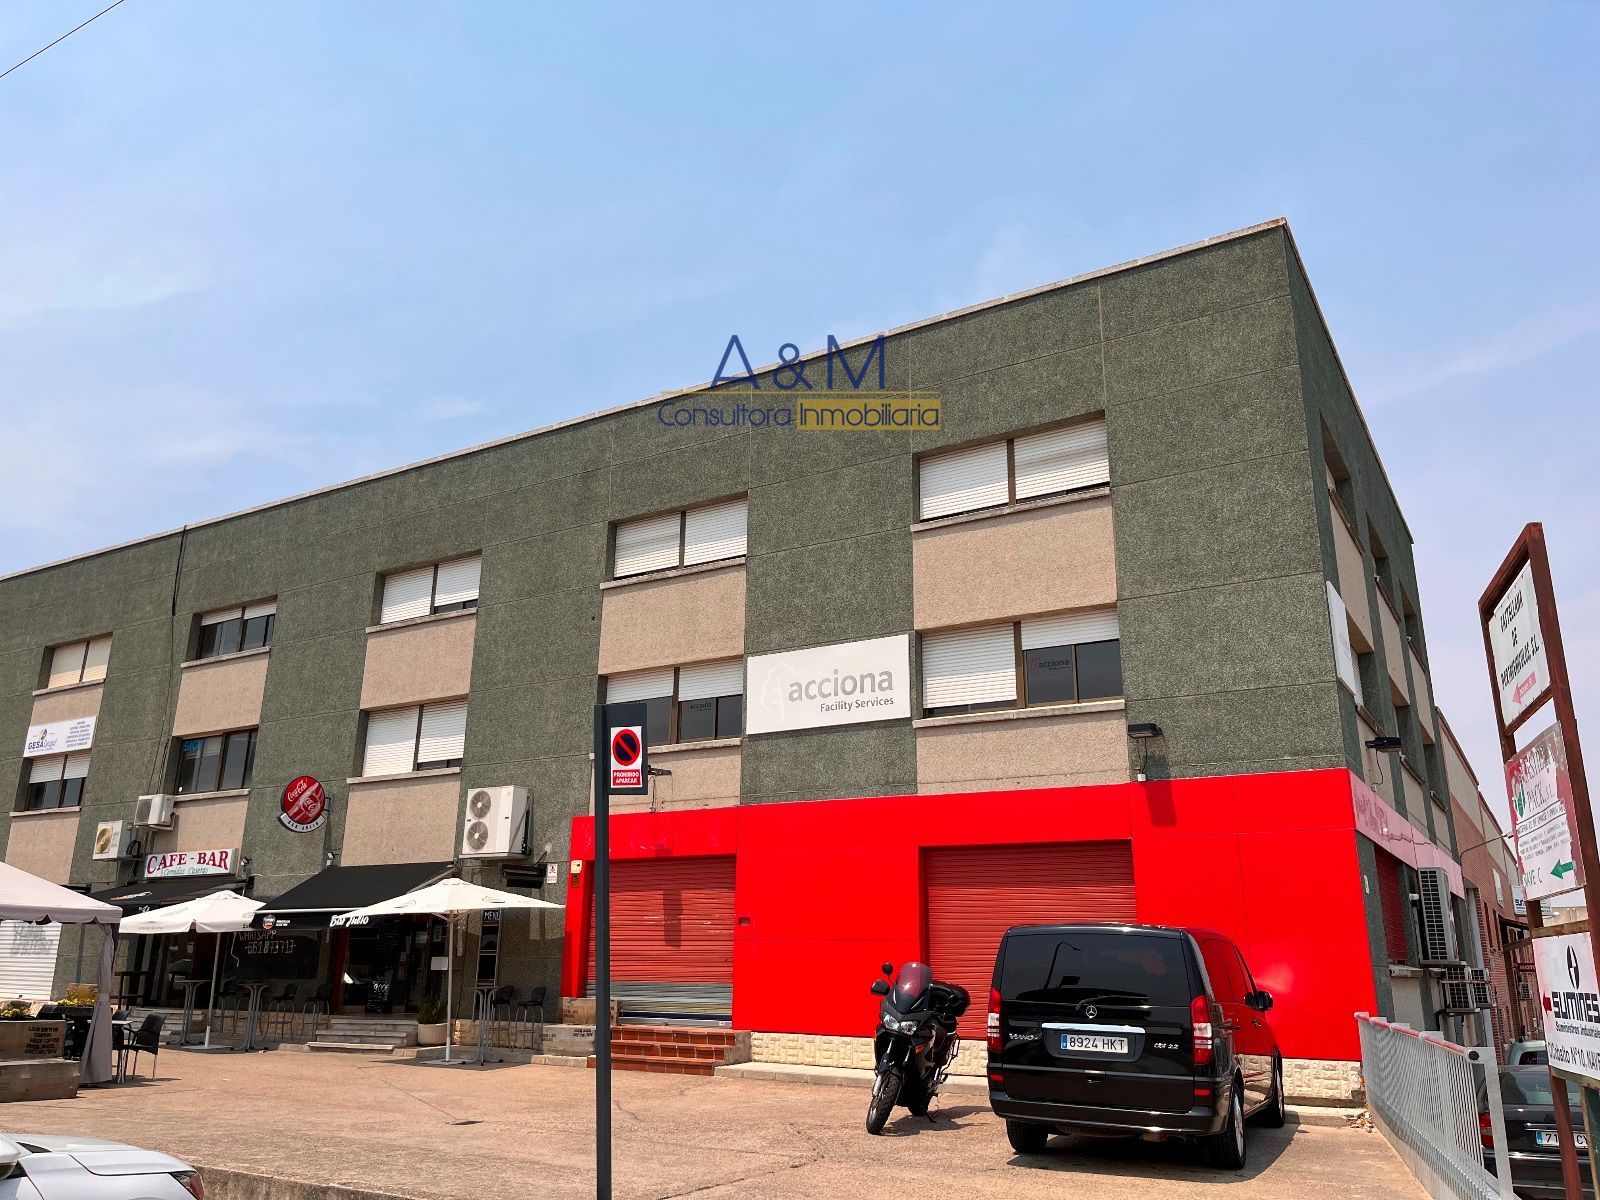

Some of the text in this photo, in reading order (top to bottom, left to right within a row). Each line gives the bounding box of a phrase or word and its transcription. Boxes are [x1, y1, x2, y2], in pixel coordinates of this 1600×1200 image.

[788, 668, 893, 702] acciona
[820, 696, 894, 713] Facility Services
[28, 740, 44, 750] GESA
[146, 853, 187, 875] CAFE
[197, 850, 229, 870] BAR
[1069, 1036, 1126, 1051] 8924 HKT
